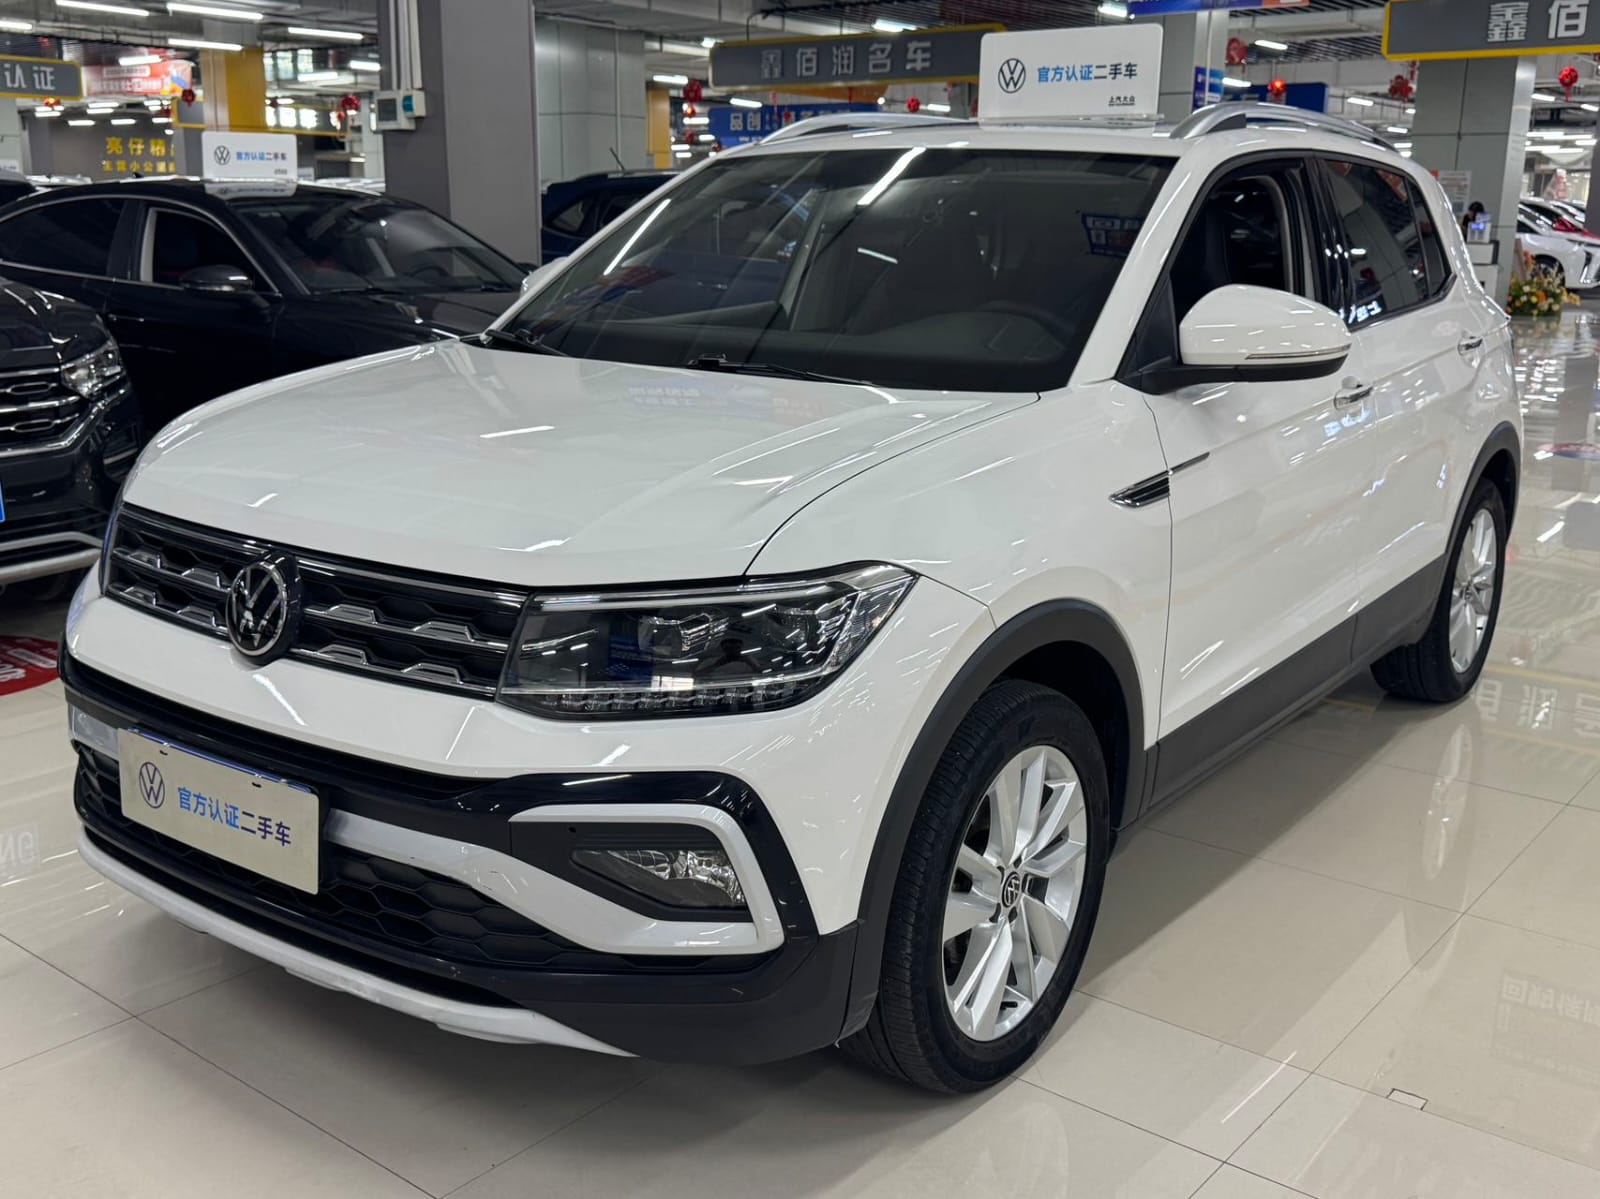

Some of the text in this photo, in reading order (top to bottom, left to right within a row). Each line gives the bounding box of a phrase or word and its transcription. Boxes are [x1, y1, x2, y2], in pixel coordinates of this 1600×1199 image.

[3, 63, 56, 91] 认证
[1037, 62, 1138, 83] 官方认证二手车
[178, 786, 292, 847] 官方认证二手车
